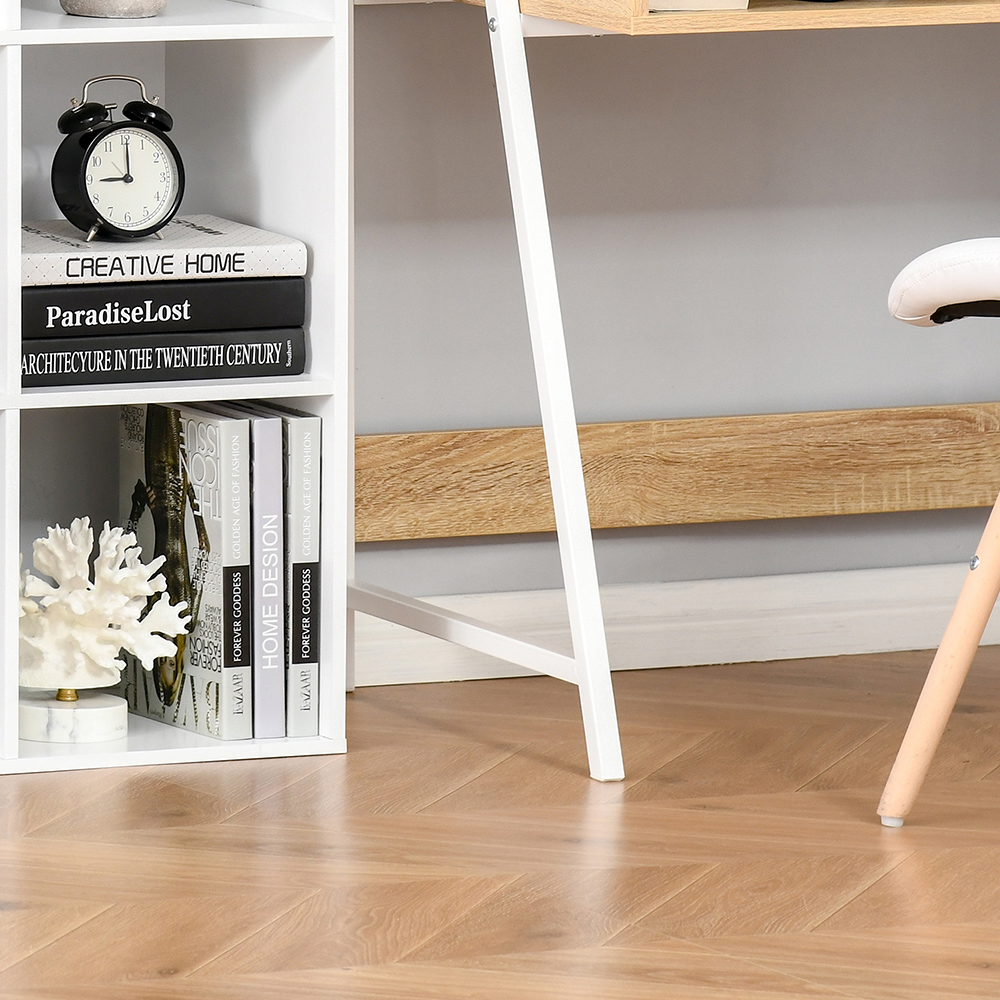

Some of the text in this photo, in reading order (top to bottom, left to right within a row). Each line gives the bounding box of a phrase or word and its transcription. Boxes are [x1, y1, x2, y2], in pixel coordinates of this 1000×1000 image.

[104, 141, 112, 152] 11
[140, 139, 146, 150] 1
[92, 156, 102, 168] 10
[152, 152, 160, 164] 2
[86, 174, 94, 186] 9
[160, 172, 166, 183] 3
[92, 193, 100, 204] 8
[154, 190, 160, 202] 4
[107, 206, 114, 218] 7
[124, 211, 132, 223] 6
[142, 206, 150, 218] 5
[66, 252, 246, 278] CREATIVE HOME
[46, 299, 191, 328] ParadiseLost
[21, 342, 282, 376] ARCHITECYURE IN THE TWENTIETH CENTURY
[178, 418, 219, 457] ISSUE
[178, 448, 220, 490] ICON
[194, 484, 222, 521] THE
[232, 436, 241, 560] GOLDEN AGE OF FASHION
[302, 432, 312, 556] GOLDEN AGE OF FASHION
[262, 514, 278, 670] HOME DESIGN
[233, 572, 242, 662] FOREVER GODDESS
[302, 568, 310, 658] FOREVER GODDESS
[190, 636, 222, 658] FASHION
[190, 650, 222, 673] FOREVER
